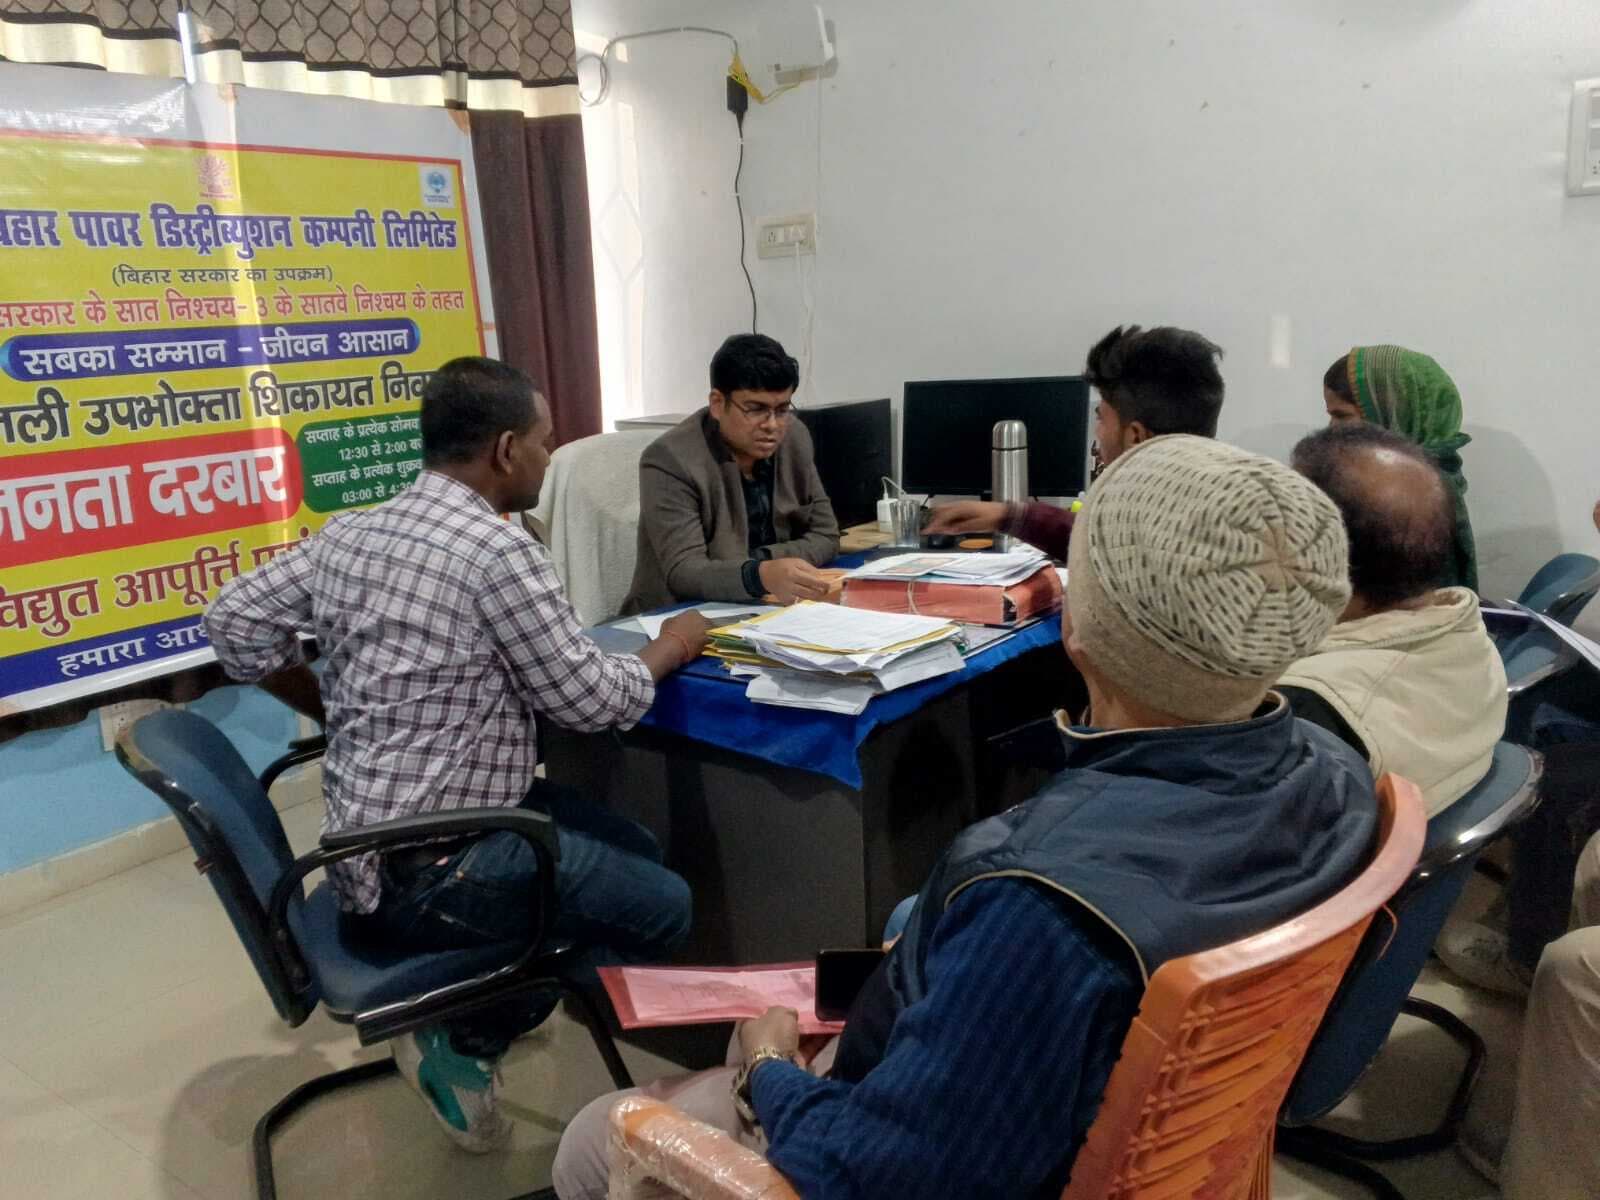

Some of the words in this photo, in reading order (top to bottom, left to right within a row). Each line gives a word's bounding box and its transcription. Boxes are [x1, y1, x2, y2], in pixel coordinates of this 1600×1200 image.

[68, 211, 143, 247] पावर
[300, 210, 376, 247] कम्पनी
[382, 211, 457, 248] लिमिटेड
[112, 264, 172, 286] (बिहार
[178, 268, 240, 283] सरकार
[244, 267, 267, 282] का
[273, 266, 333, 282] उपक्रम)
[82, 291, 107, 323] के
[113, 299, 159, 322] सात
[273, 286, 293, 315] के
[353, 284, 407, 312] निश्चय
[412, 284, 427, 310] के
[430, 290, 465, 310] तहत
[19, 345, 115, 376] सबका
[124, 339, 226, 369] सम्मान
[259, 326, 328, 359] जीवन
[338, 328, 409, 354] आसान
[80, 380, 241, 435] उपभोक्ता
[249, 371, 373, 418] शिकायत
[381, 361, 438, 403] निव
[343, 422, 355, 438] के
[339, 446, 368, 461] 12:30
[371, 440, 382, 456] से
[384, 441, 407, 454] 2:00
[142, 445, 287, 517] दरबार
[350, 464, 361, 480] के
[342, 488, 372, 503] 03:00
[374, 481, 385, 497] से
[57, 637, 146, 677] हमारा
